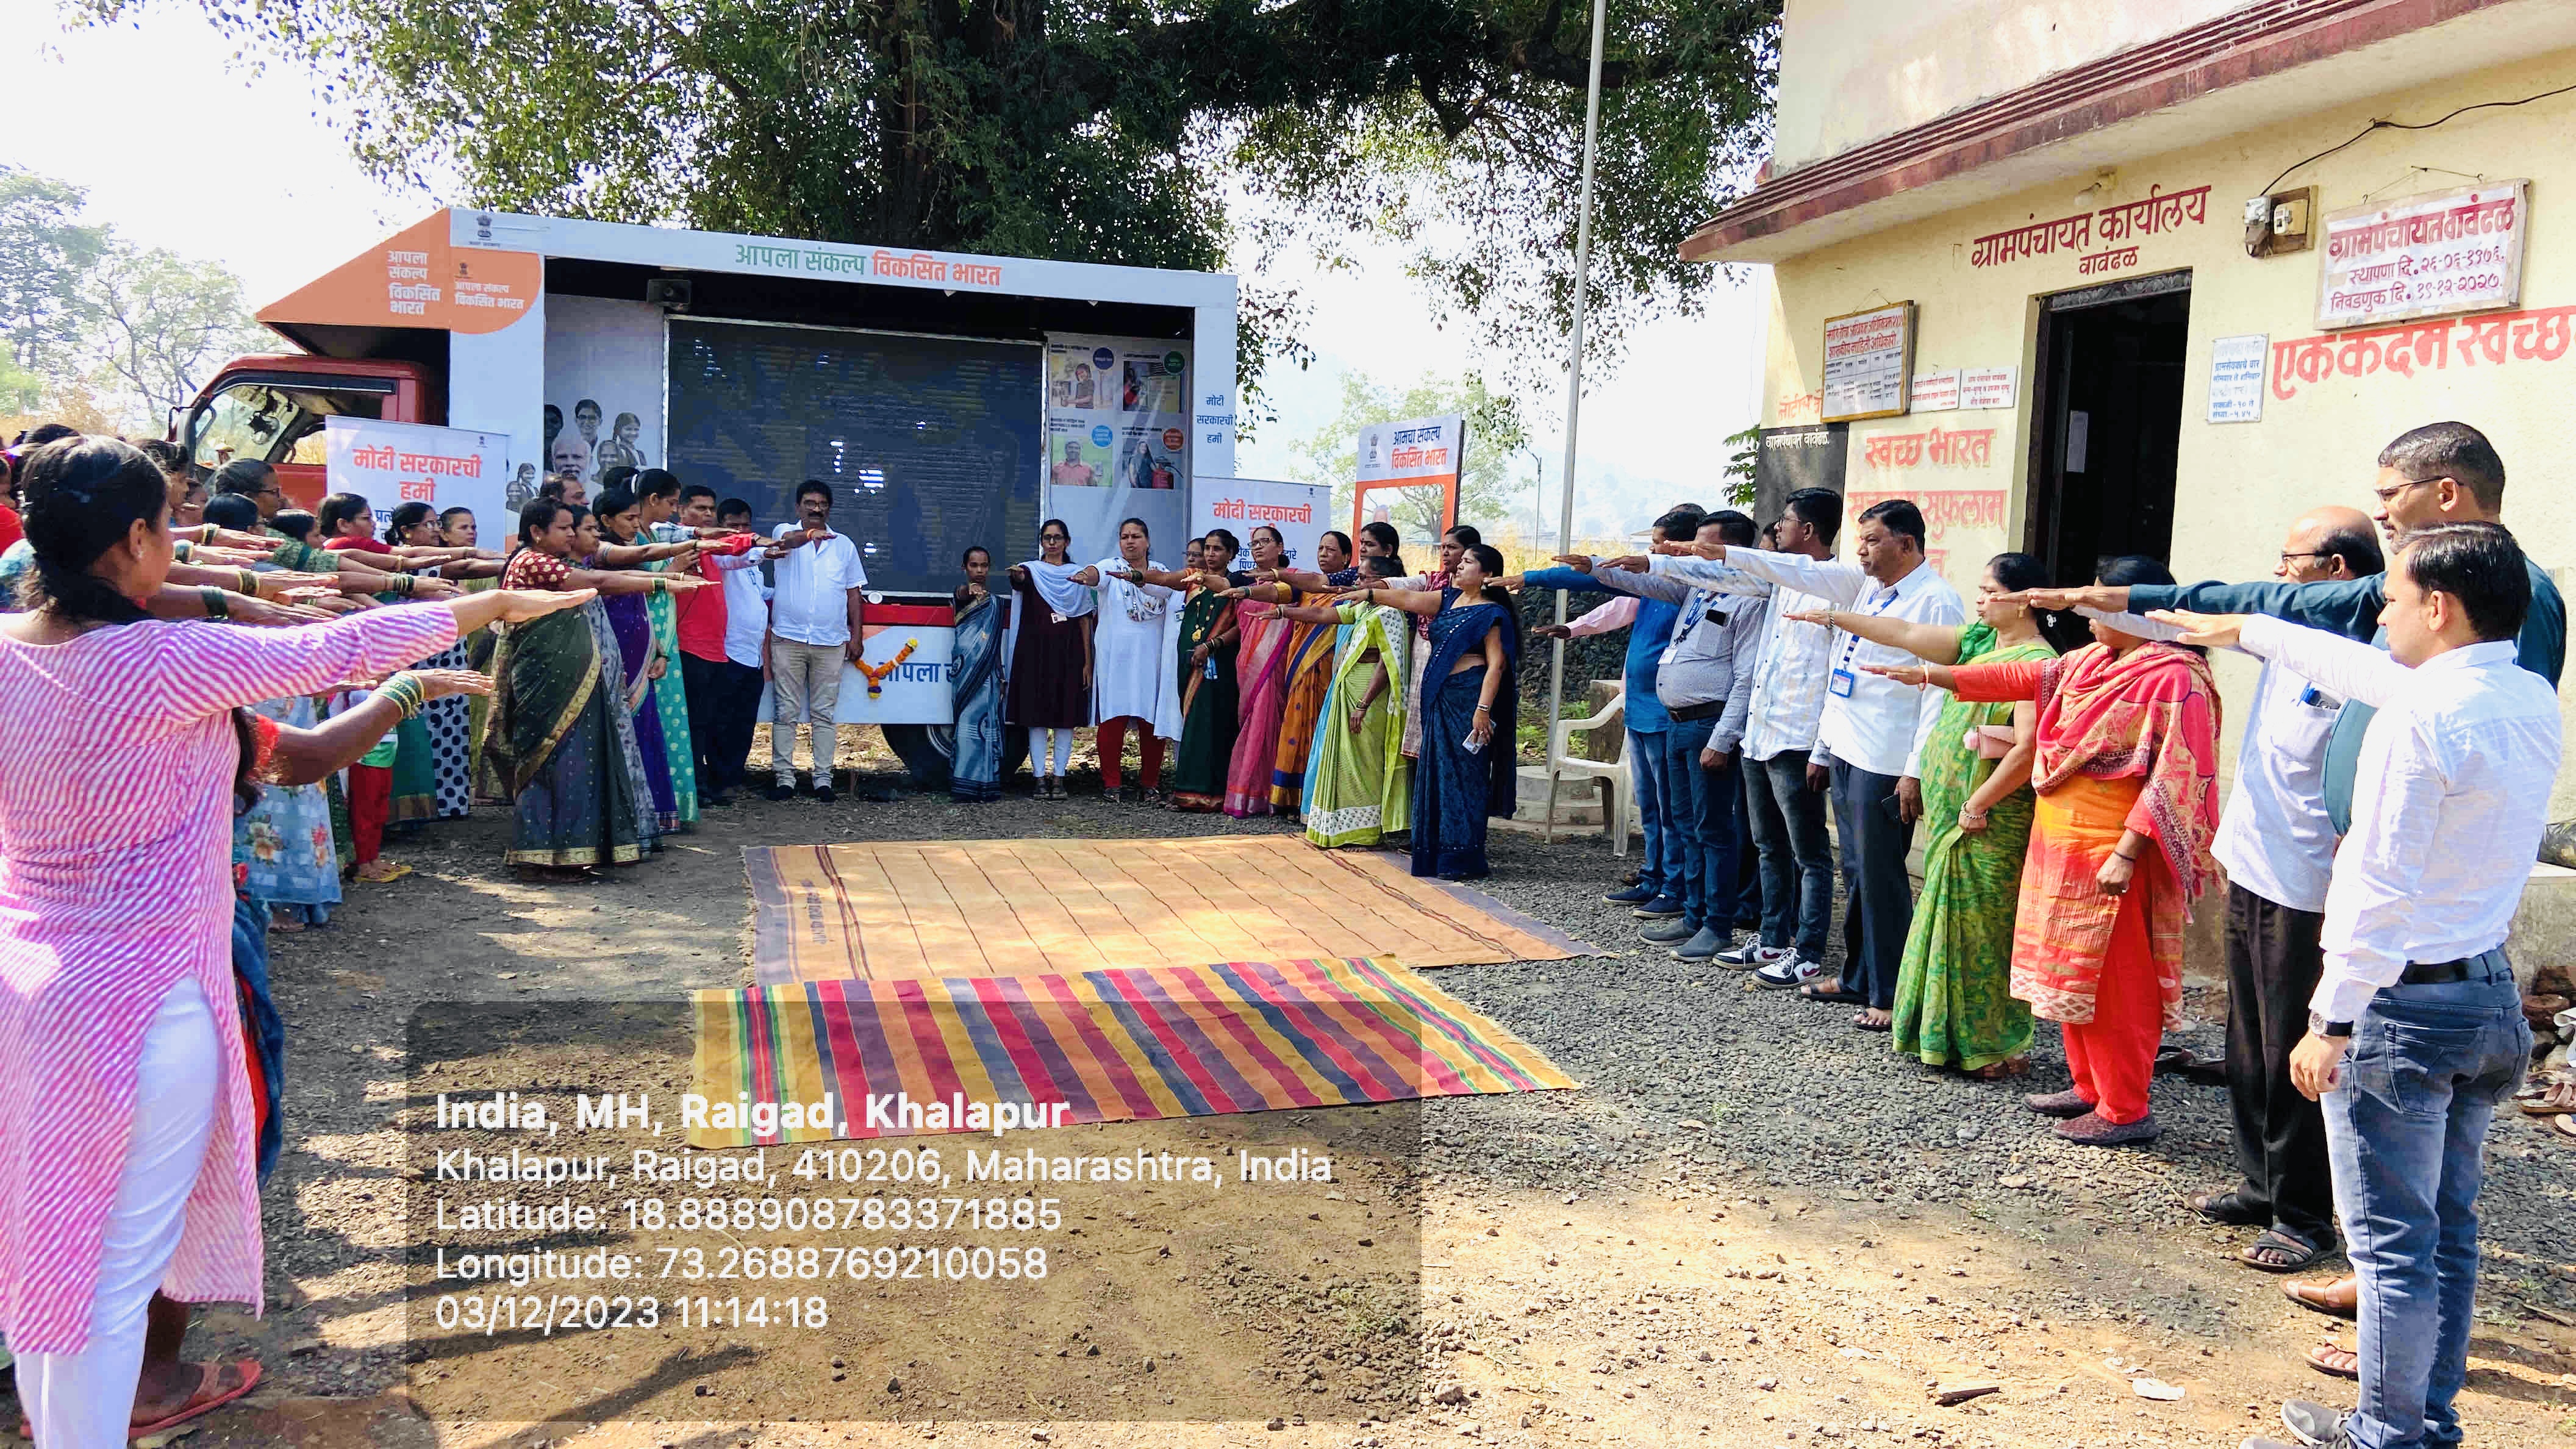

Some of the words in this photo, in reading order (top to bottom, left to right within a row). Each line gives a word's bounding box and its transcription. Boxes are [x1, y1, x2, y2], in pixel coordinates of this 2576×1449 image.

[1972, 213, 2093, 269] ग्रामपंचायत
[2098, 184, 2212, 242] कार्यालय
[387, 250, 429, 265] आपला
[735, 245, 800, 270] आपला
[804, 246, 866, 275] संकल्प
[872, 250, 948, 282] विकसित
[953, 262, 1002, 286] भारत
[2080, 246, 2139, 276] वावंढळ
[387, 265, 428, 280] संकल्प
[388, 282, 441, 301] विकसित
[455, 281, 481, 292] आपला
[390, 299, 425, 315] भारत
[455, 293, 495, 307] विकसित
[497, 298, 524, 310] भारत
[2272, 334, 2337, 401] एक
[2340, 319, 2457, 379] कदम
[2457, 305, 2576, 367] स्वच्छ
[1206, 395, 1224, 406] मोदी
[1196, 414, 1233, 426] सरकारची
[1207, 432, 1222, 444] हमी
[1393, 429, 1416, 445] आमचा
[1417, 424, 1441, 444] संकल्प
[1391, 446, 1424, 469] विकसित
[1425, 448, 1448, 467] भारत
[1865, 434, 1926, 469] स्वच्छ
[1928, 426, 1996, 468] भारत
[352, 444, 395, 471] मोदी
[399, 453, 482, 478] सरकारची
[399, 478, 436, 502] हमी
[1212, 498, 1245, 519] मोदी
[1248, 503, 1312, 524] सरकारची
